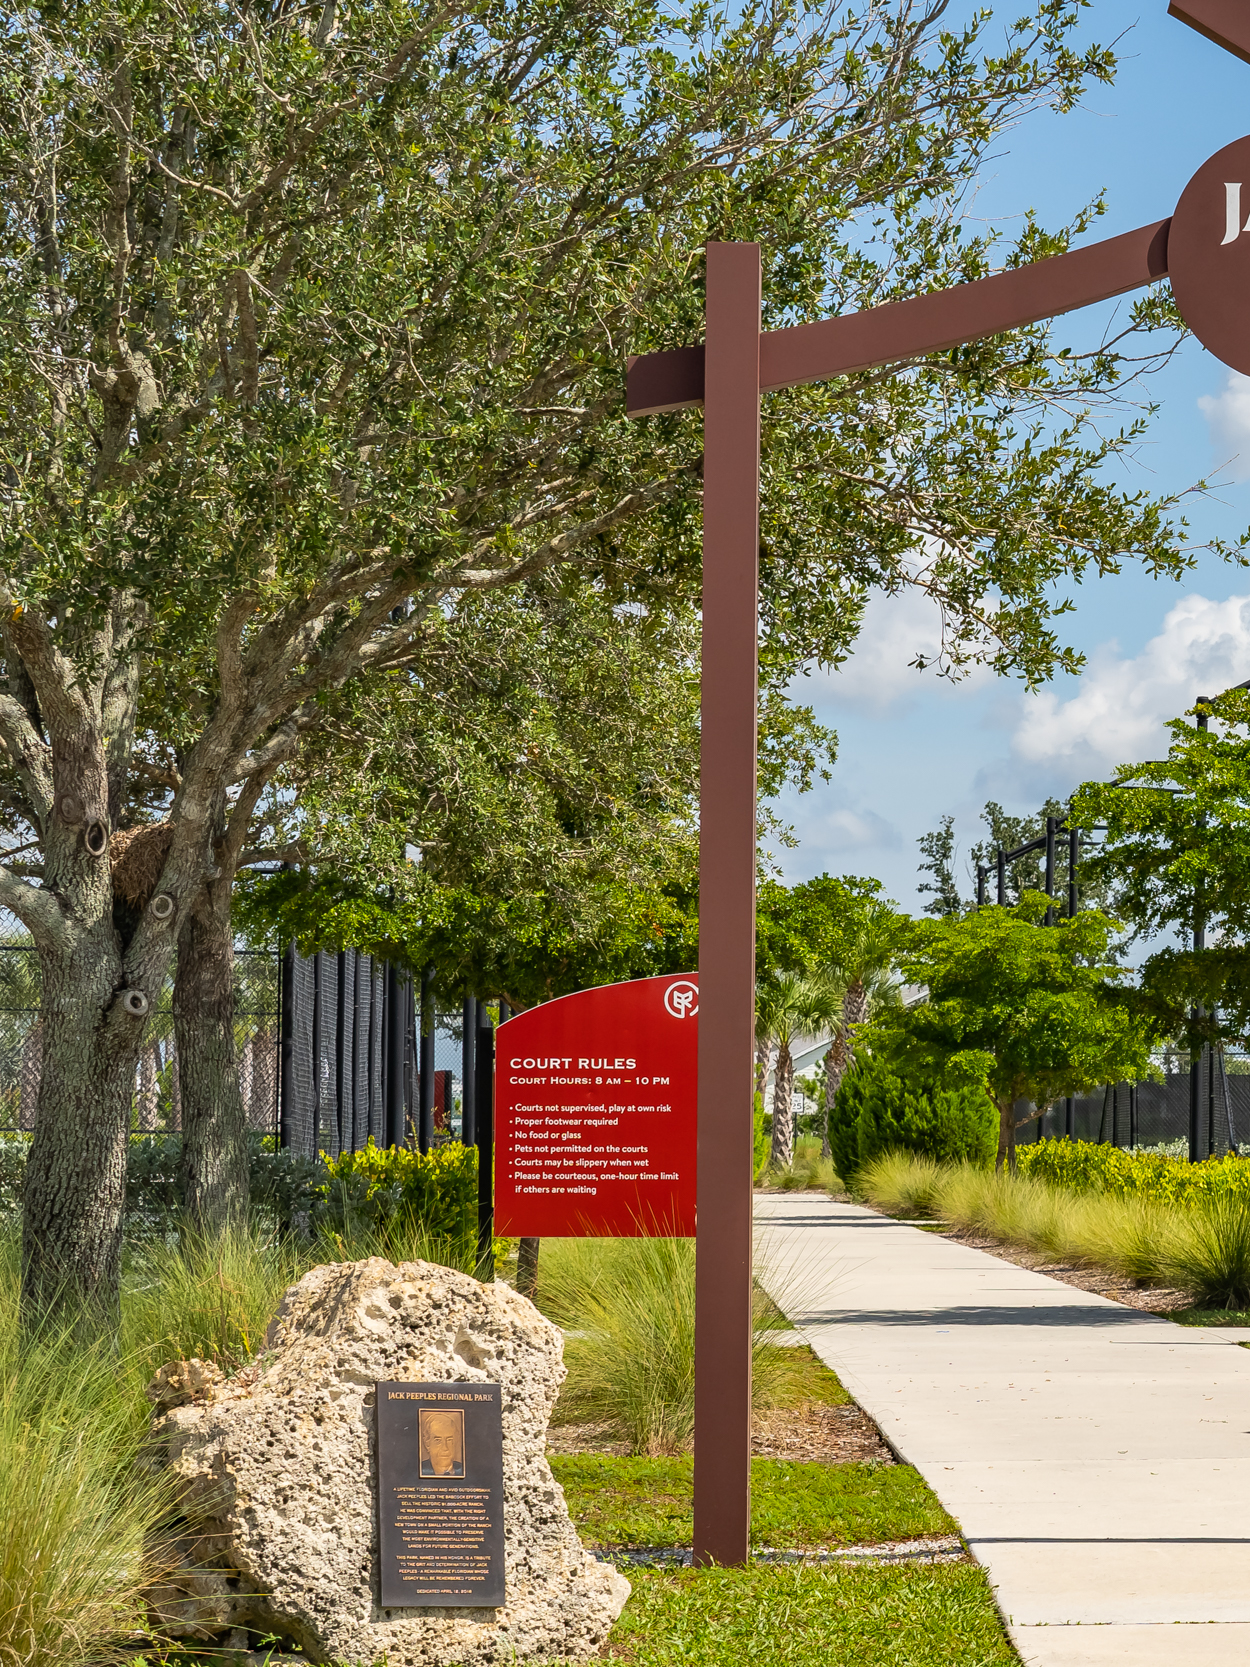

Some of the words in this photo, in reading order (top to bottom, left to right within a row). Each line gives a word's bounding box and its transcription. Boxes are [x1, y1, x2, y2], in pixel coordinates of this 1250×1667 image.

[510, 1058, 572, 1069] COURT
[578, 1058, 636, 1069] RULES
[595, 1076, 603, 1085] 8
[605, 1077, 621, 1085] AM
[635, 1077, 649, 1085] 10
[652, 1077, 670, 1085] PM
[515, 1103, 543, 1111] Courts
[561, 1104, 607, 1114] supervised,
[609, 1104, 626, 1114] play
[656, 1104, 671, 1112] risk
[515, 1117, 543, 1127] Proper
[545, 1117, 582, 1125] footwear
[584, 1118, 618, 1127] required
[515, 1131, 527, 1139] No
[529, 1131, 549, 1139] food
[561, 1131, 581, 1141] glass
[515, 1144, 533, 1152] Pets
[550, 1144, 592, 1154] permitted
[606, 1145, 620, 1153] the
[514, 1158, 543, 1166] Courts
[544, 1160, 562, 1168] may
[563, 1158, 574, 1166] be
[575, 1158, 608, 1168] slippery
[609, 1158, 632, 1166] when
[514, 1171, 541, 1180] Please
[542, 1172, 553, 1180] be
[554, 1172, 598, 1181] courteous,
[600, 1172, 638, 1180] one-hour
[640, 1172, 659, 1180] time
[660, 1172, 679, 1180] limit
[515, 1185, 522, 1193] if
[523, 1185, 550, 1193] others
[567, 1185, 597, 1195] waiting
[388, 1391, 405, 1400] JACK
[406, 1392, 437, 1401] PEEPLES
[437, 1393, 473, 1401] REGIONAL
